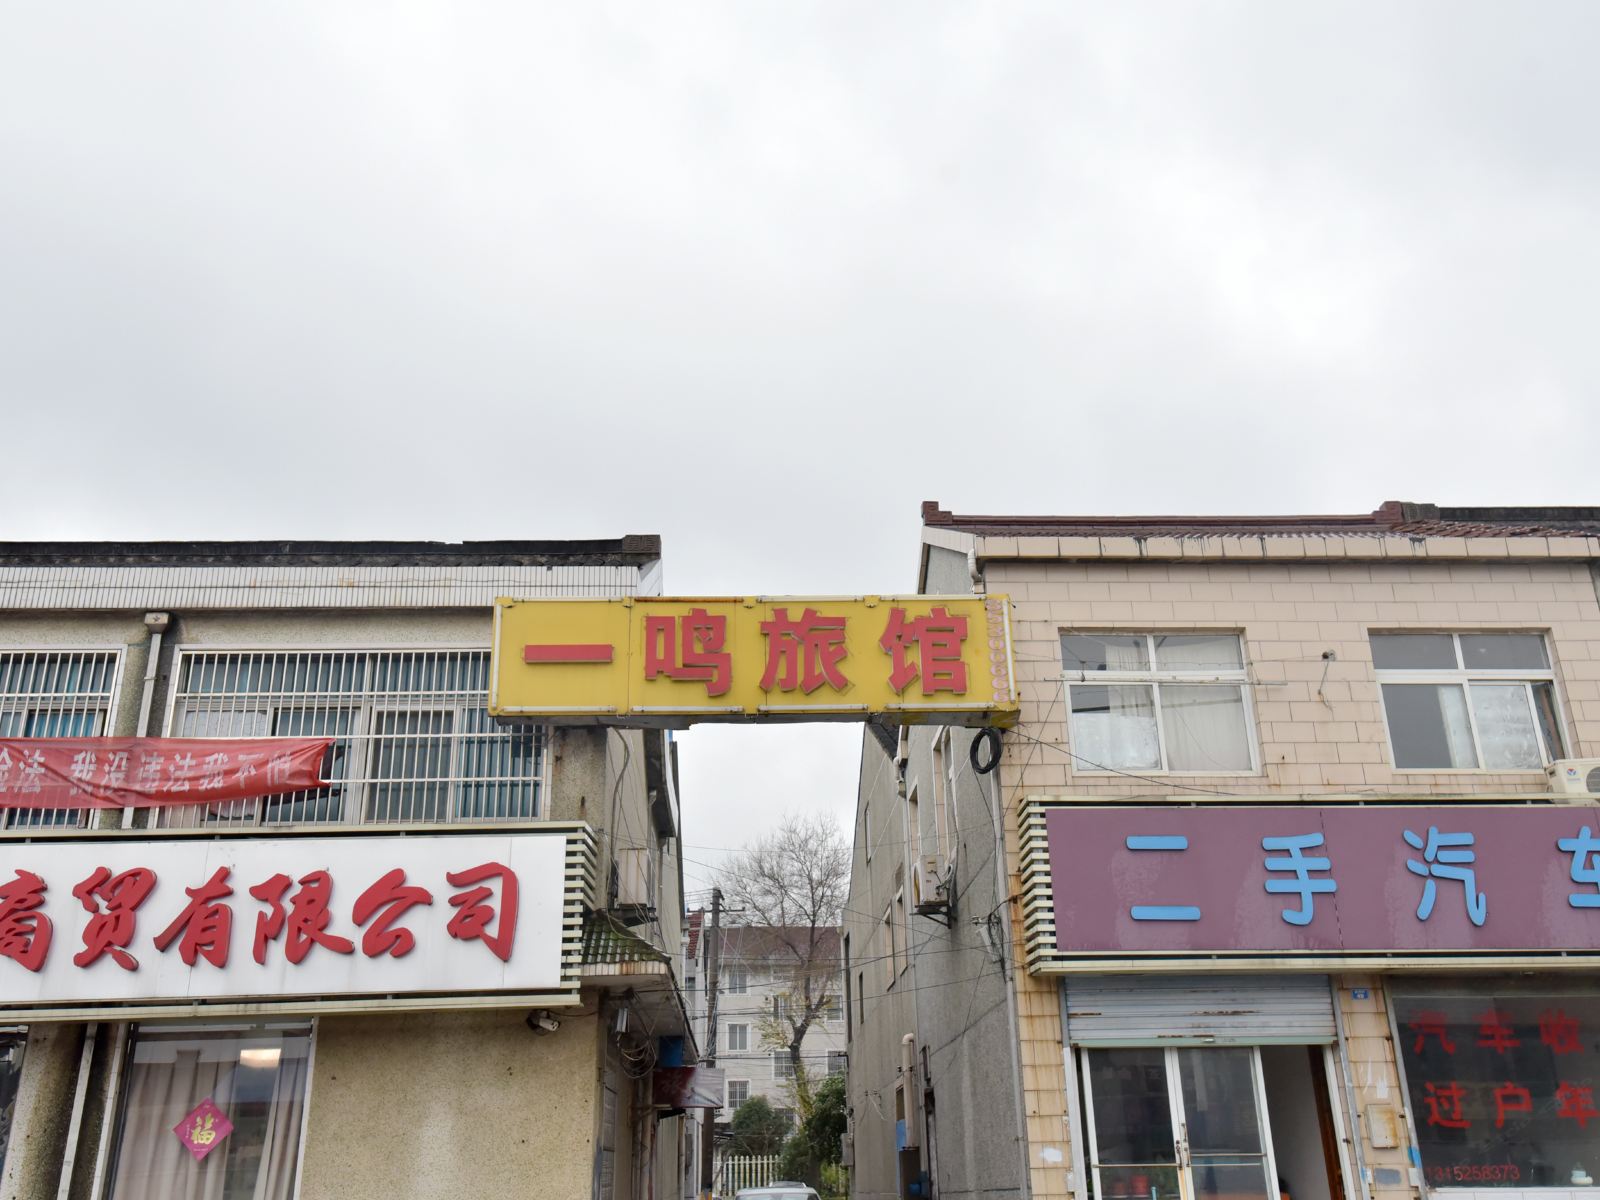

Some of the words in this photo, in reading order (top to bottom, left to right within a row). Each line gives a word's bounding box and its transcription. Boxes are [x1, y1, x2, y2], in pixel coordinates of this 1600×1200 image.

[524, 607, 969, 698] 一鸣旅馆
[0, 862, 520, 972] 商贸有限公司
[191, 1112, 216, 1145] 福
[1424, 1080, 1600, 1128] 过户年
